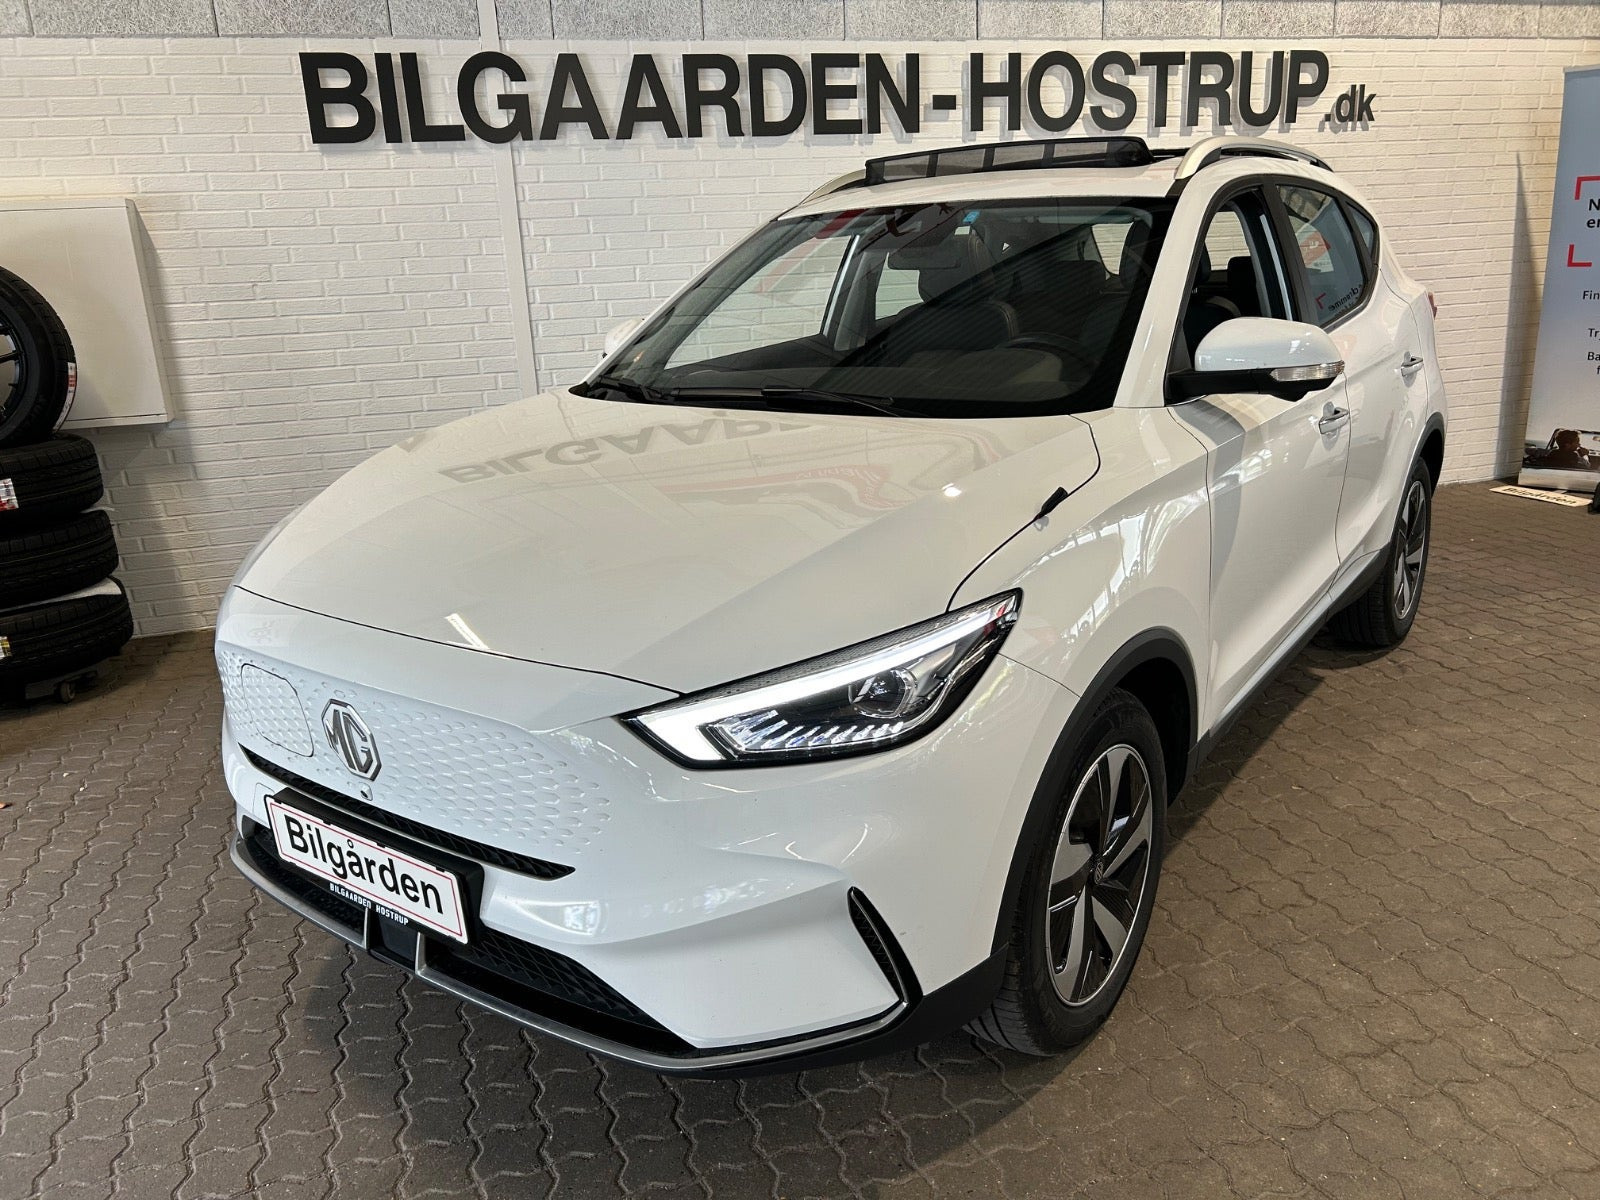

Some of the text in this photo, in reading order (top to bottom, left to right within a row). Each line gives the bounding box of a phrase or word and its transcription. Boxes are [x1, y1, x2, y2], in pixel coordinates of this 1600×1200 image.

[1588, 327, 1600, 341] Tr
[324, 704, 377, 778] MG
[284, 814, 444, 914] Bilgården
[329, 882, 409, 926] BILGAARDEN HOSTRUP
